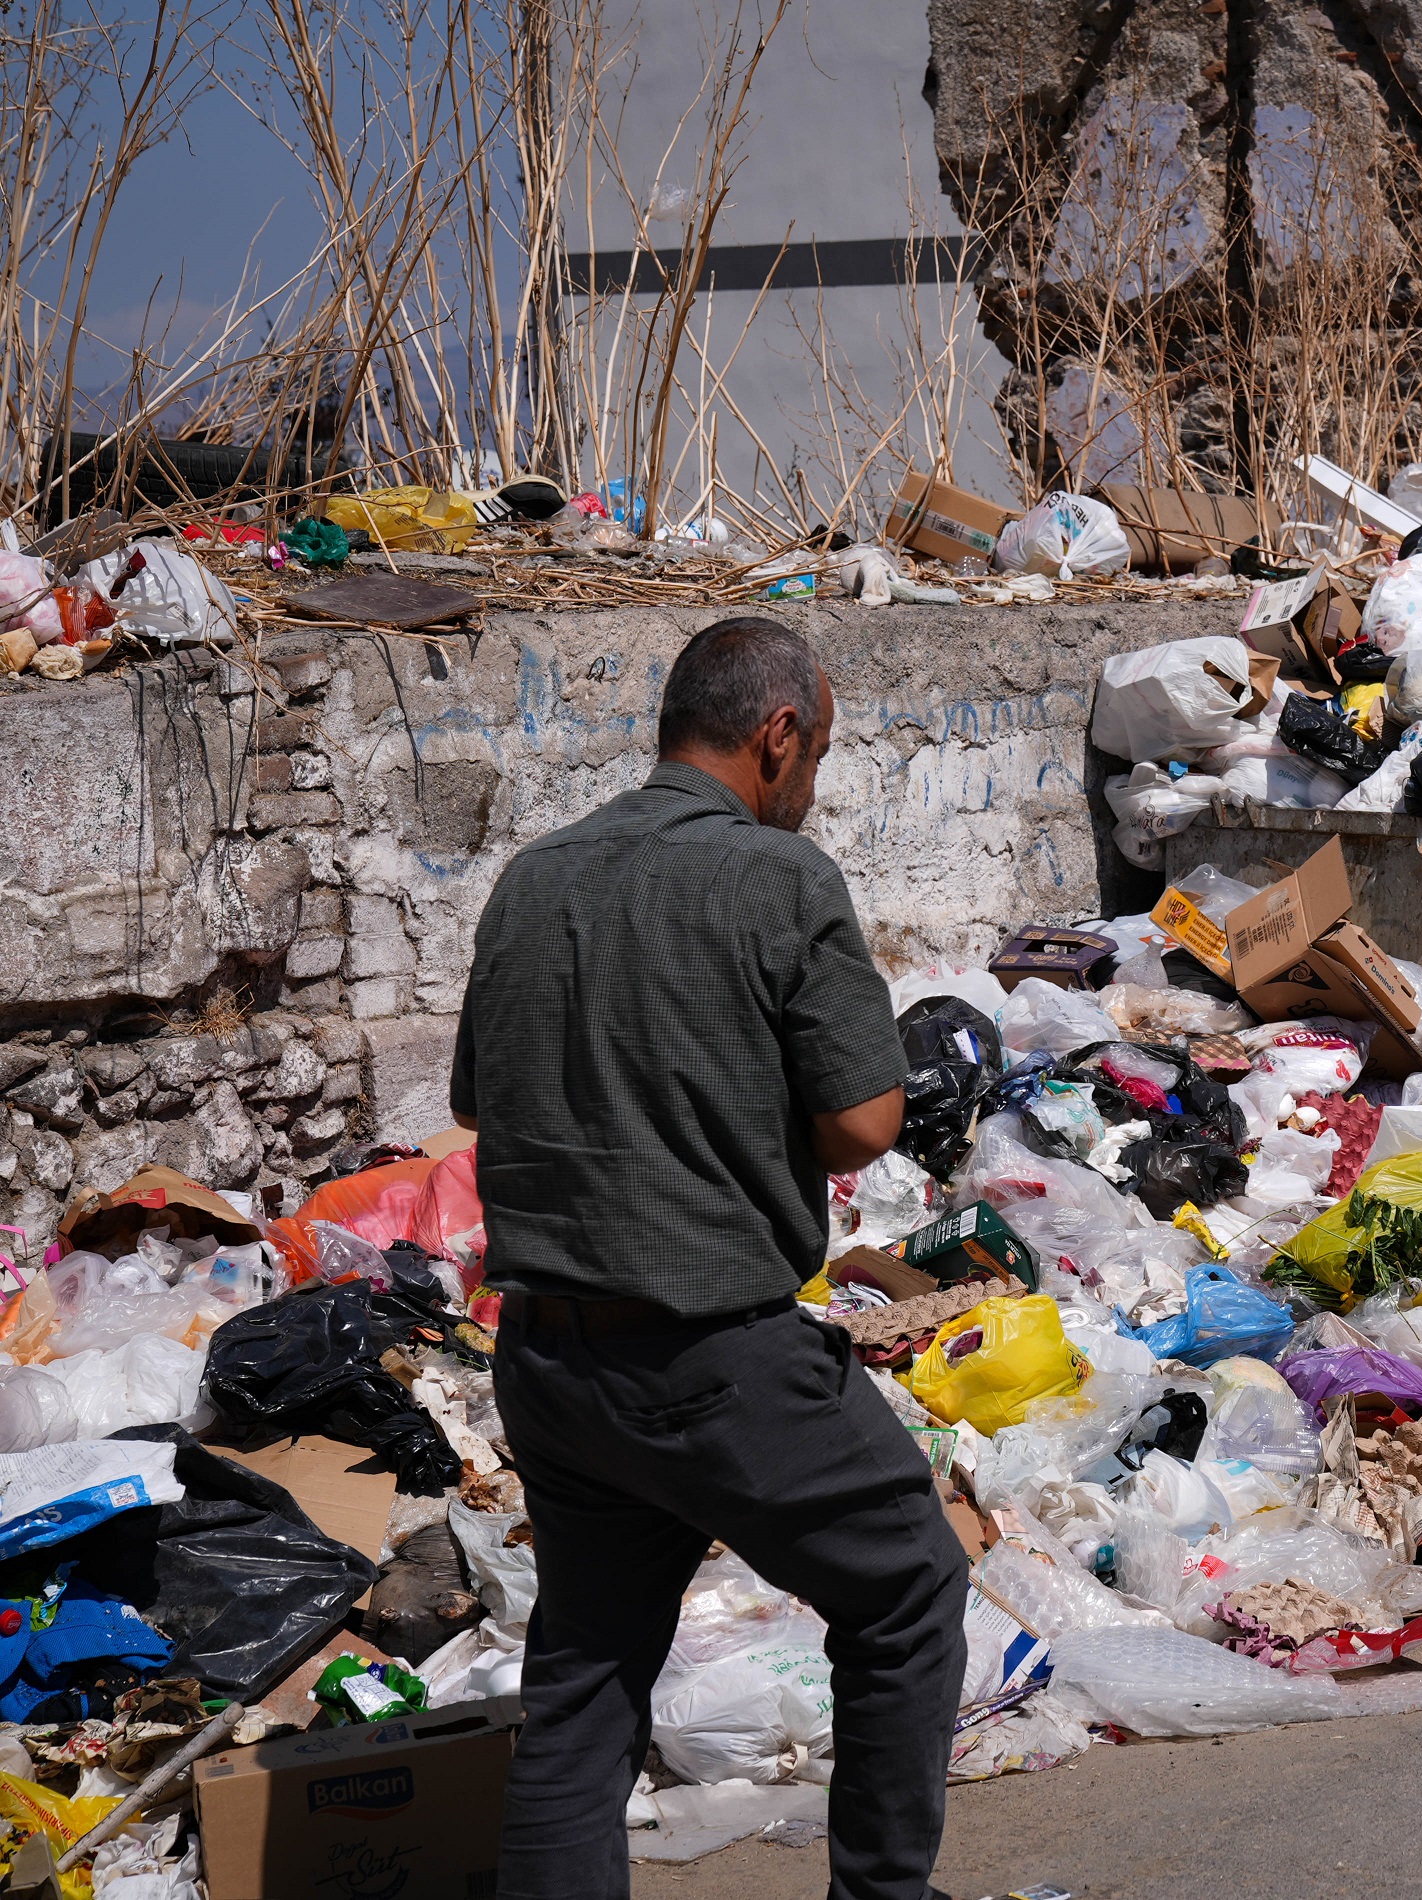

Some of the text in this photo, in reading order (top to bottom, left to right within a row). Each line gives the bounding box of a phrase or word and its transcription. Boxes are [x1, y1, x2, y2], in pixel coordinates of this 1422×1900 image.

[1371, 964, 1396, 995] Domino's
[1281, 1032, 1350, 1046] Sultan
[960, 1707, 990, 1728] Gong
[314, 1775, 408, 1806] Balkan
